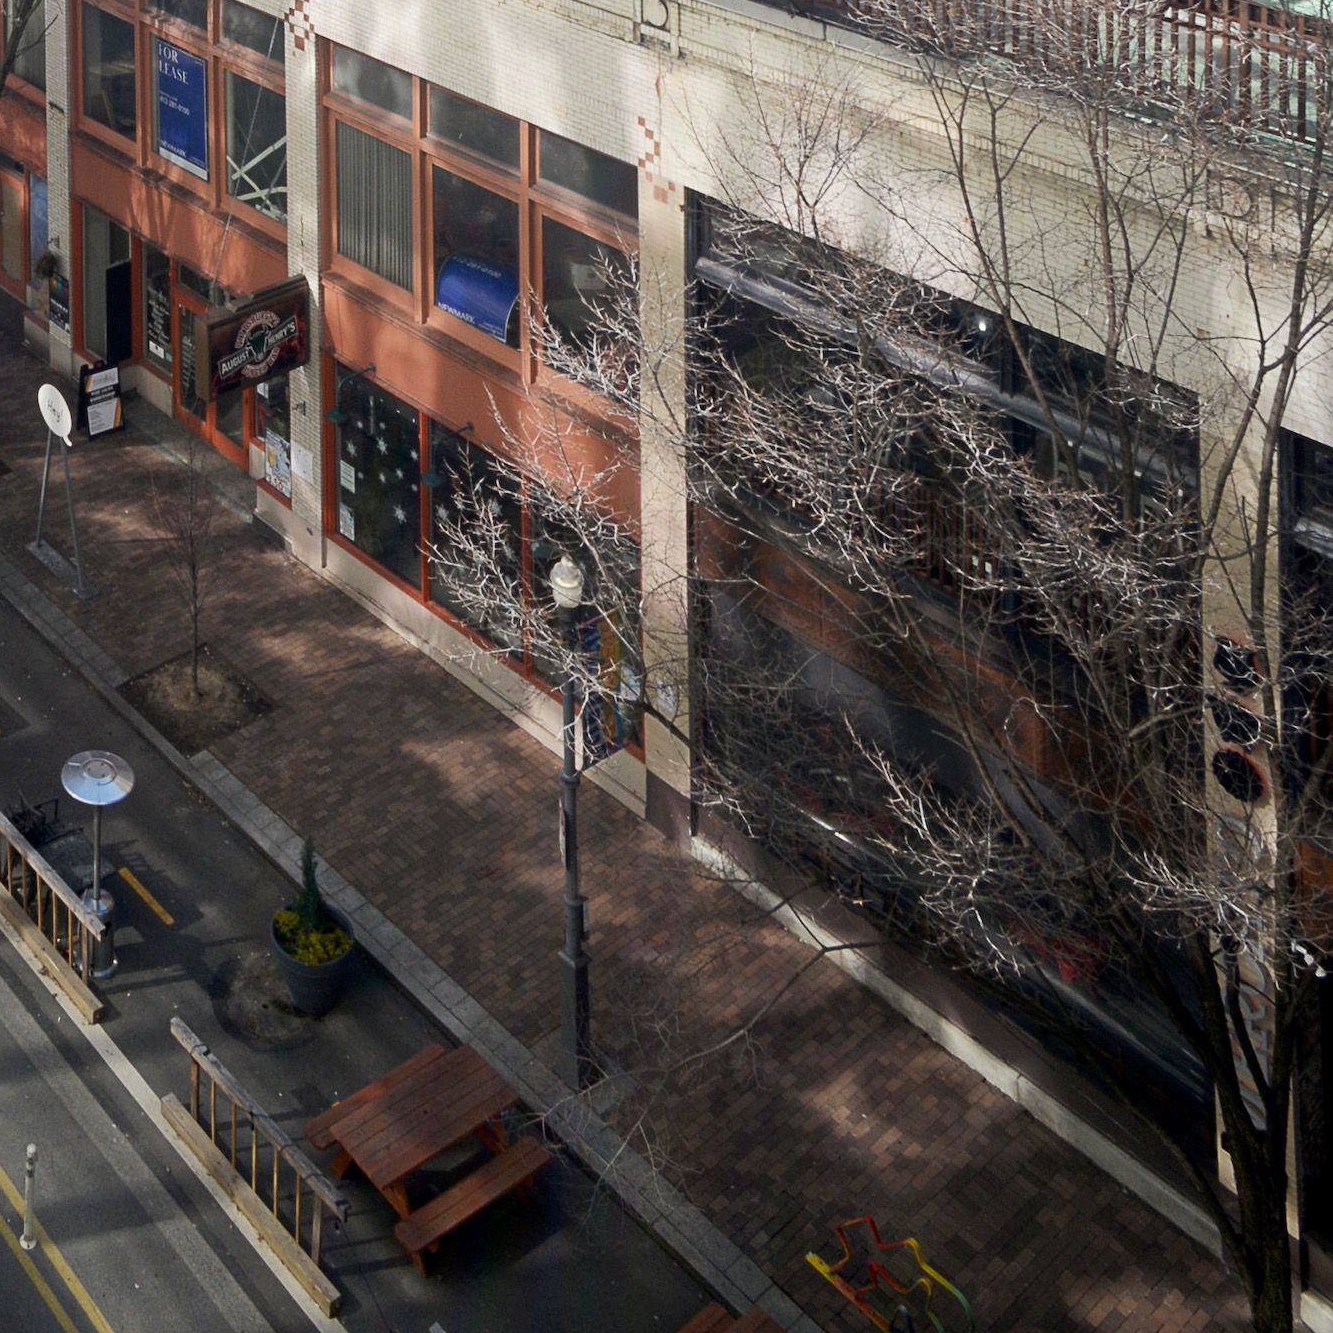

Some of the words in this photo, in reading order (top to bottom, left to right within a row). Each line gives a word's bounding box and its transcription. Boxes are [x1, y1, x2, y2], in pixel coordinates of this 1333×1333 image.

[158, 43, 179, 64] FOR
[158, 60, 189, 85] LEASE
[437, 301, 476, 325] NEWMARK
[220, 350, 251, 375] AUGUST
[267, 321, 296, 346] HENRY'S
[47, 398, 64, 423] Hey!
